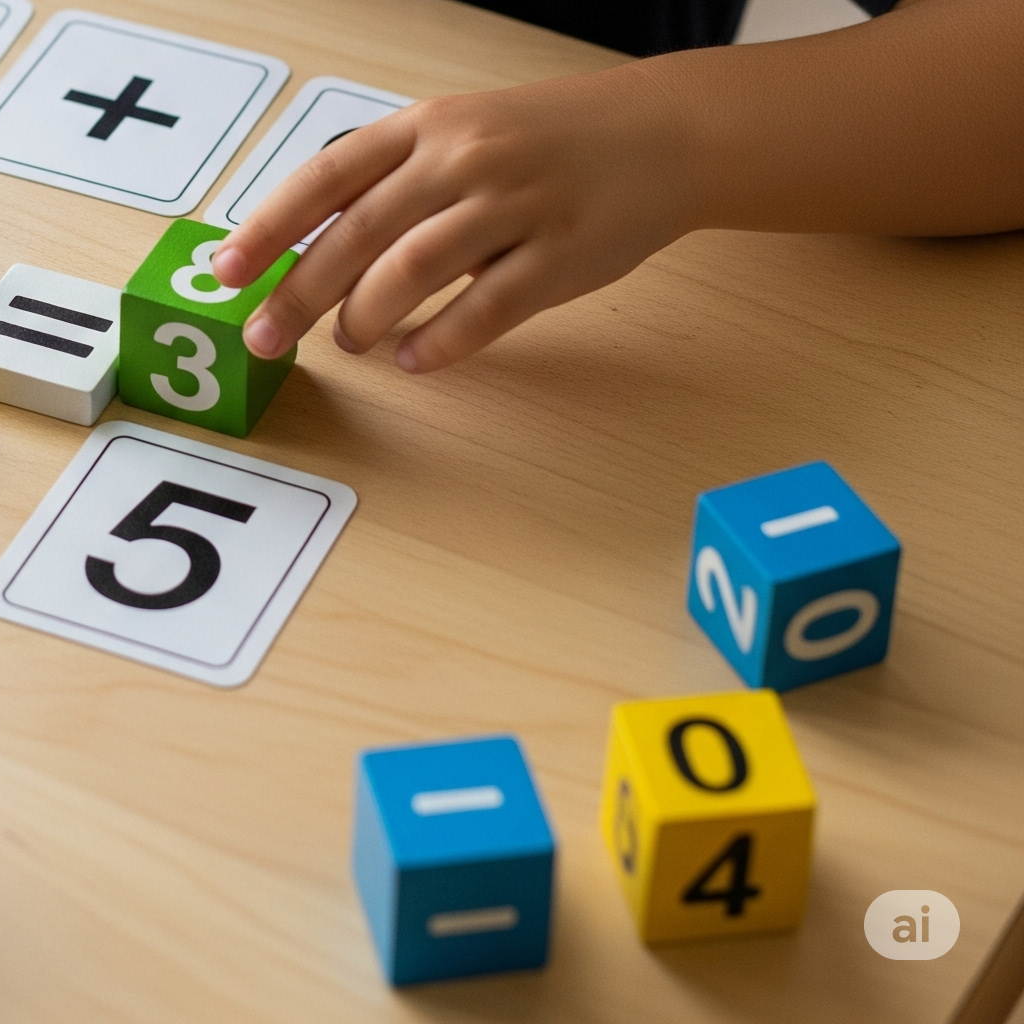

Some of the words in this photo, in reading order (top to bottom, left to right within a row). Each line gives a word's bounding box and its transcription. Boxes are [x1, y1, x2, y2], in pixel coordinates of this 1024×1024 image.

[171, 240, 243, 303] 8
[150, 322, 220, 412] 3
[85, 480, 257, 611] 5
[694, 545, 758, 655] 2
[681, 831, 762, 918] 4
